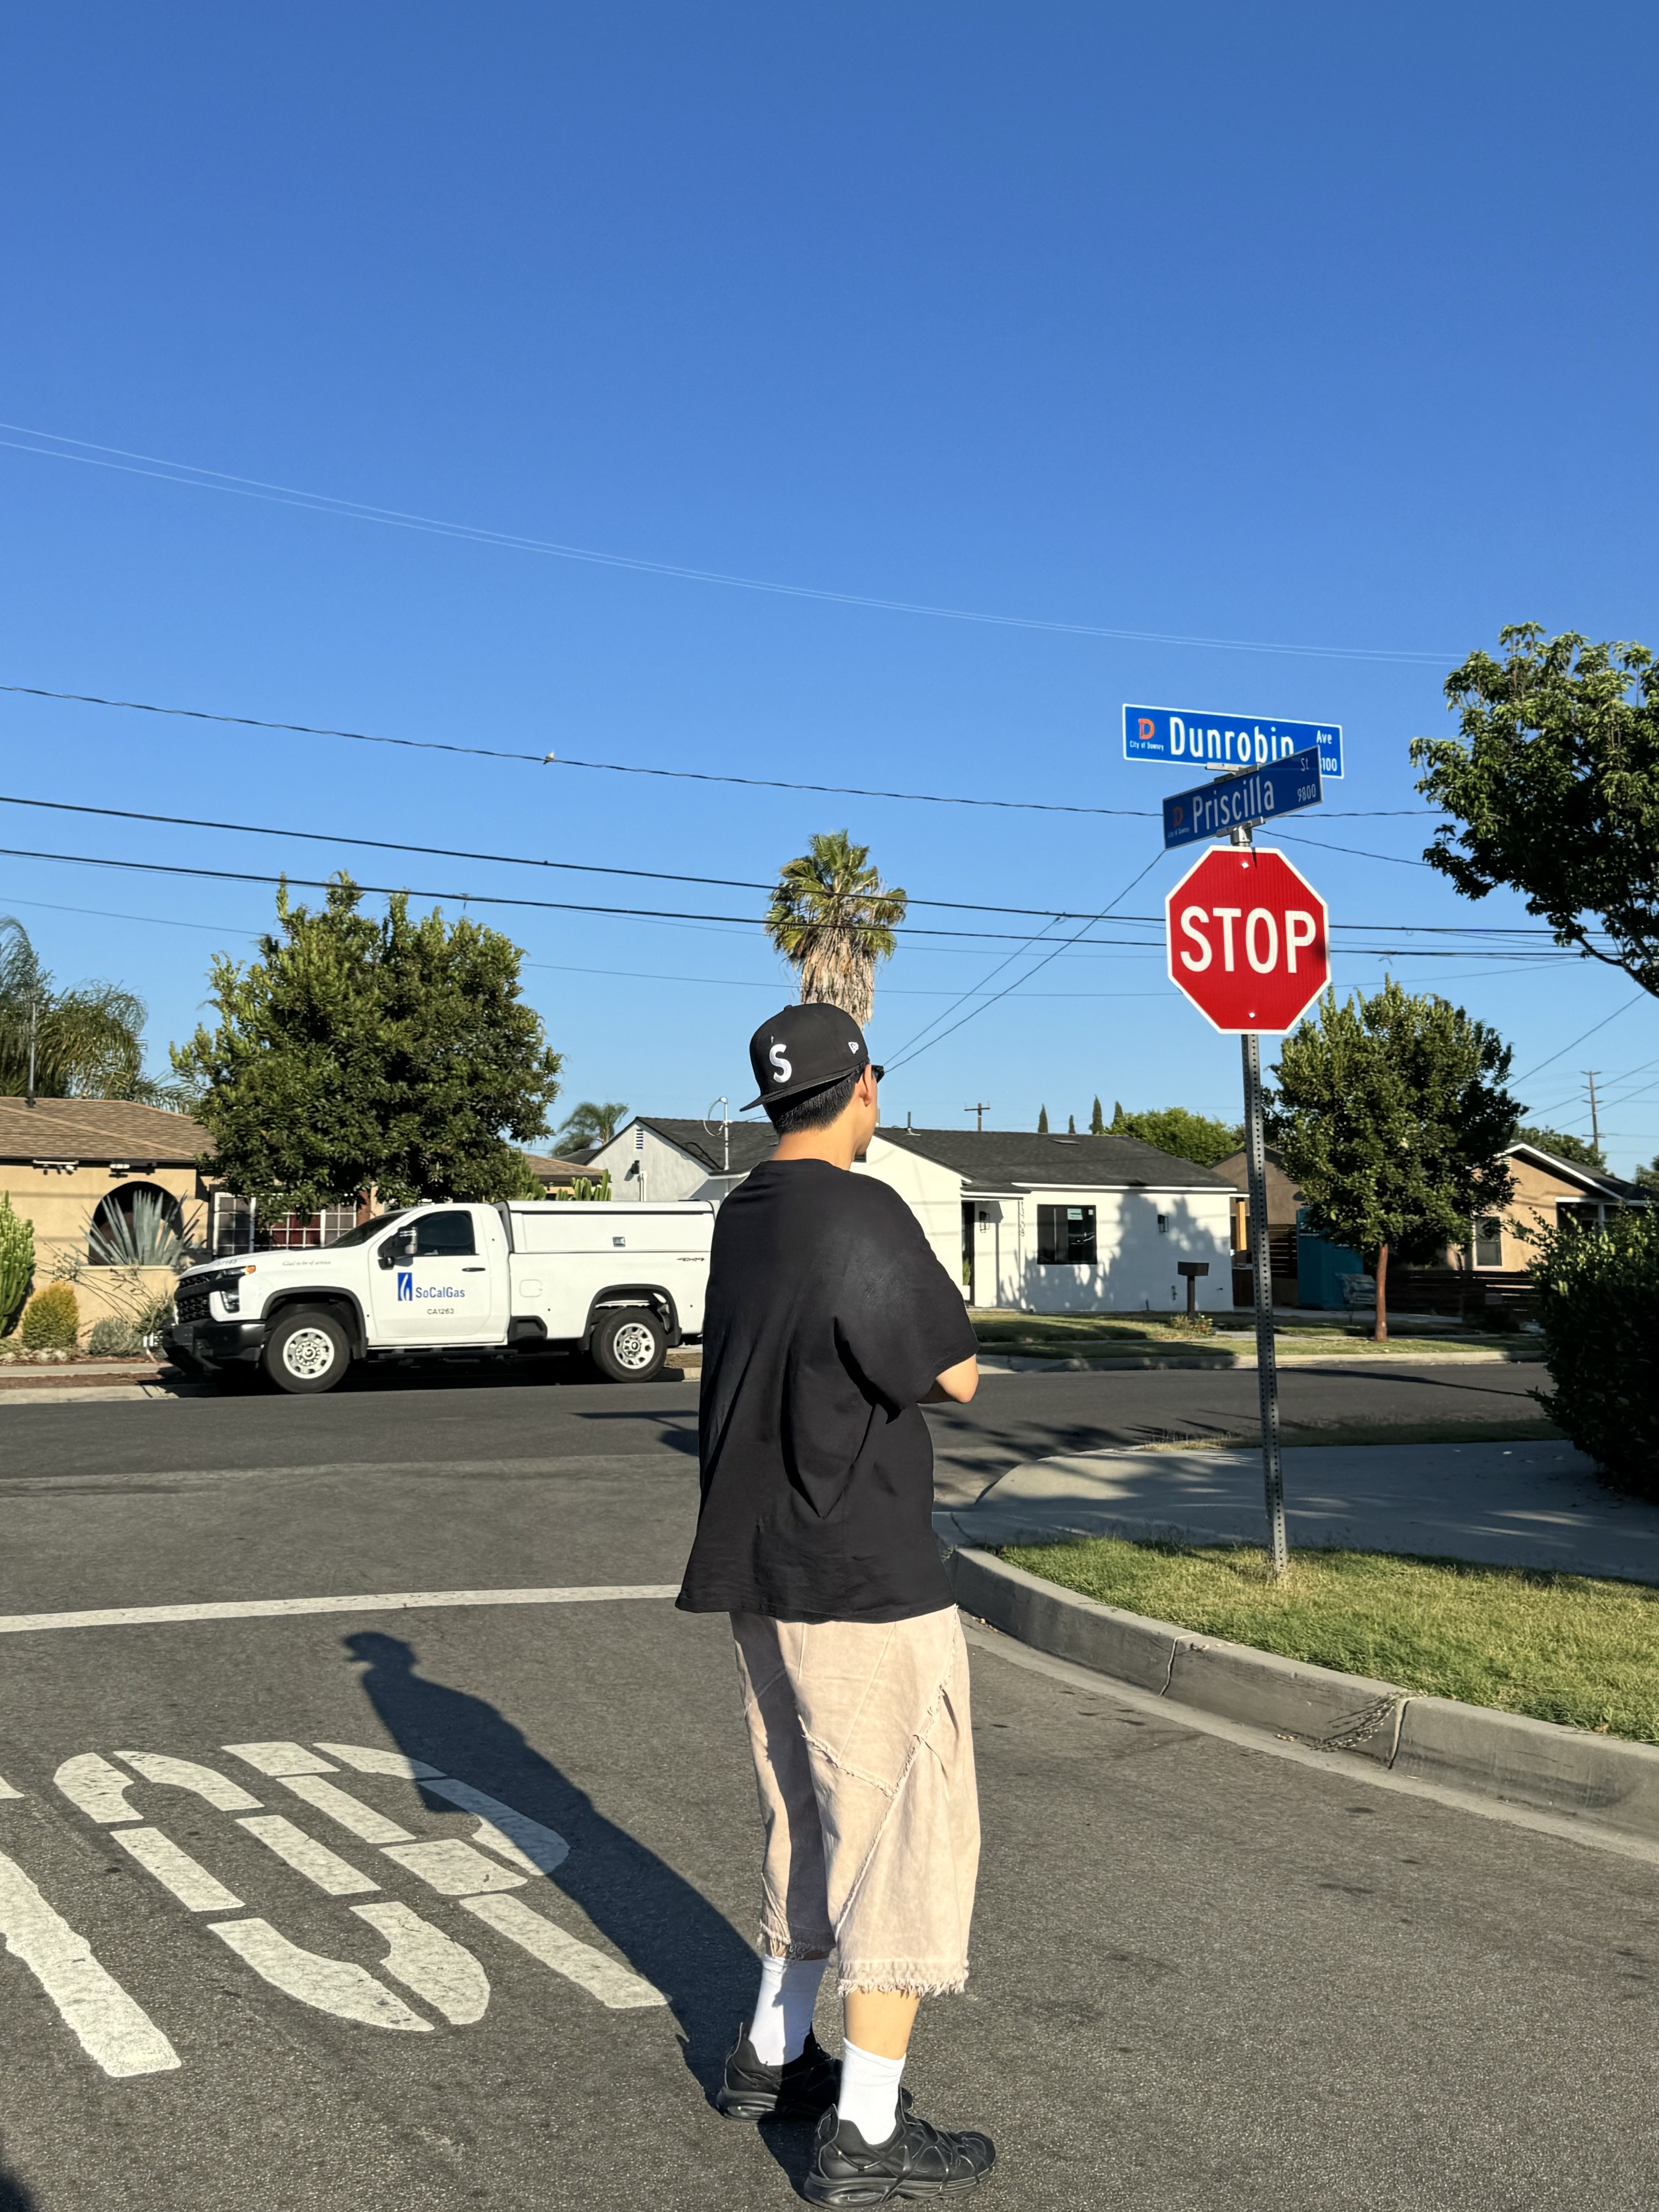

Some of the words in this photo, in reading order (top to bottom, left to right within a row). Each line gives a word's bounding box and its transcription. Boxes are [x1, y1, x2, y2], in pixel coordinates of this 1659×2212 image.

[1170, 717, 1294, 764] Dunrobin
[1316, 730, 1332, 744] Ave
[1321, 758, 1337, 772] 100
[1193, 776, 1275, 833] Priscilla
[1301, 758, 1309, 771] St
[1297, 784, 1316, 802] 9800
[1180, 906, 1316, 973] STOP
[769, 1044, 792, 1083] S
[416, 1287, 465, 1298] SoCalGas
